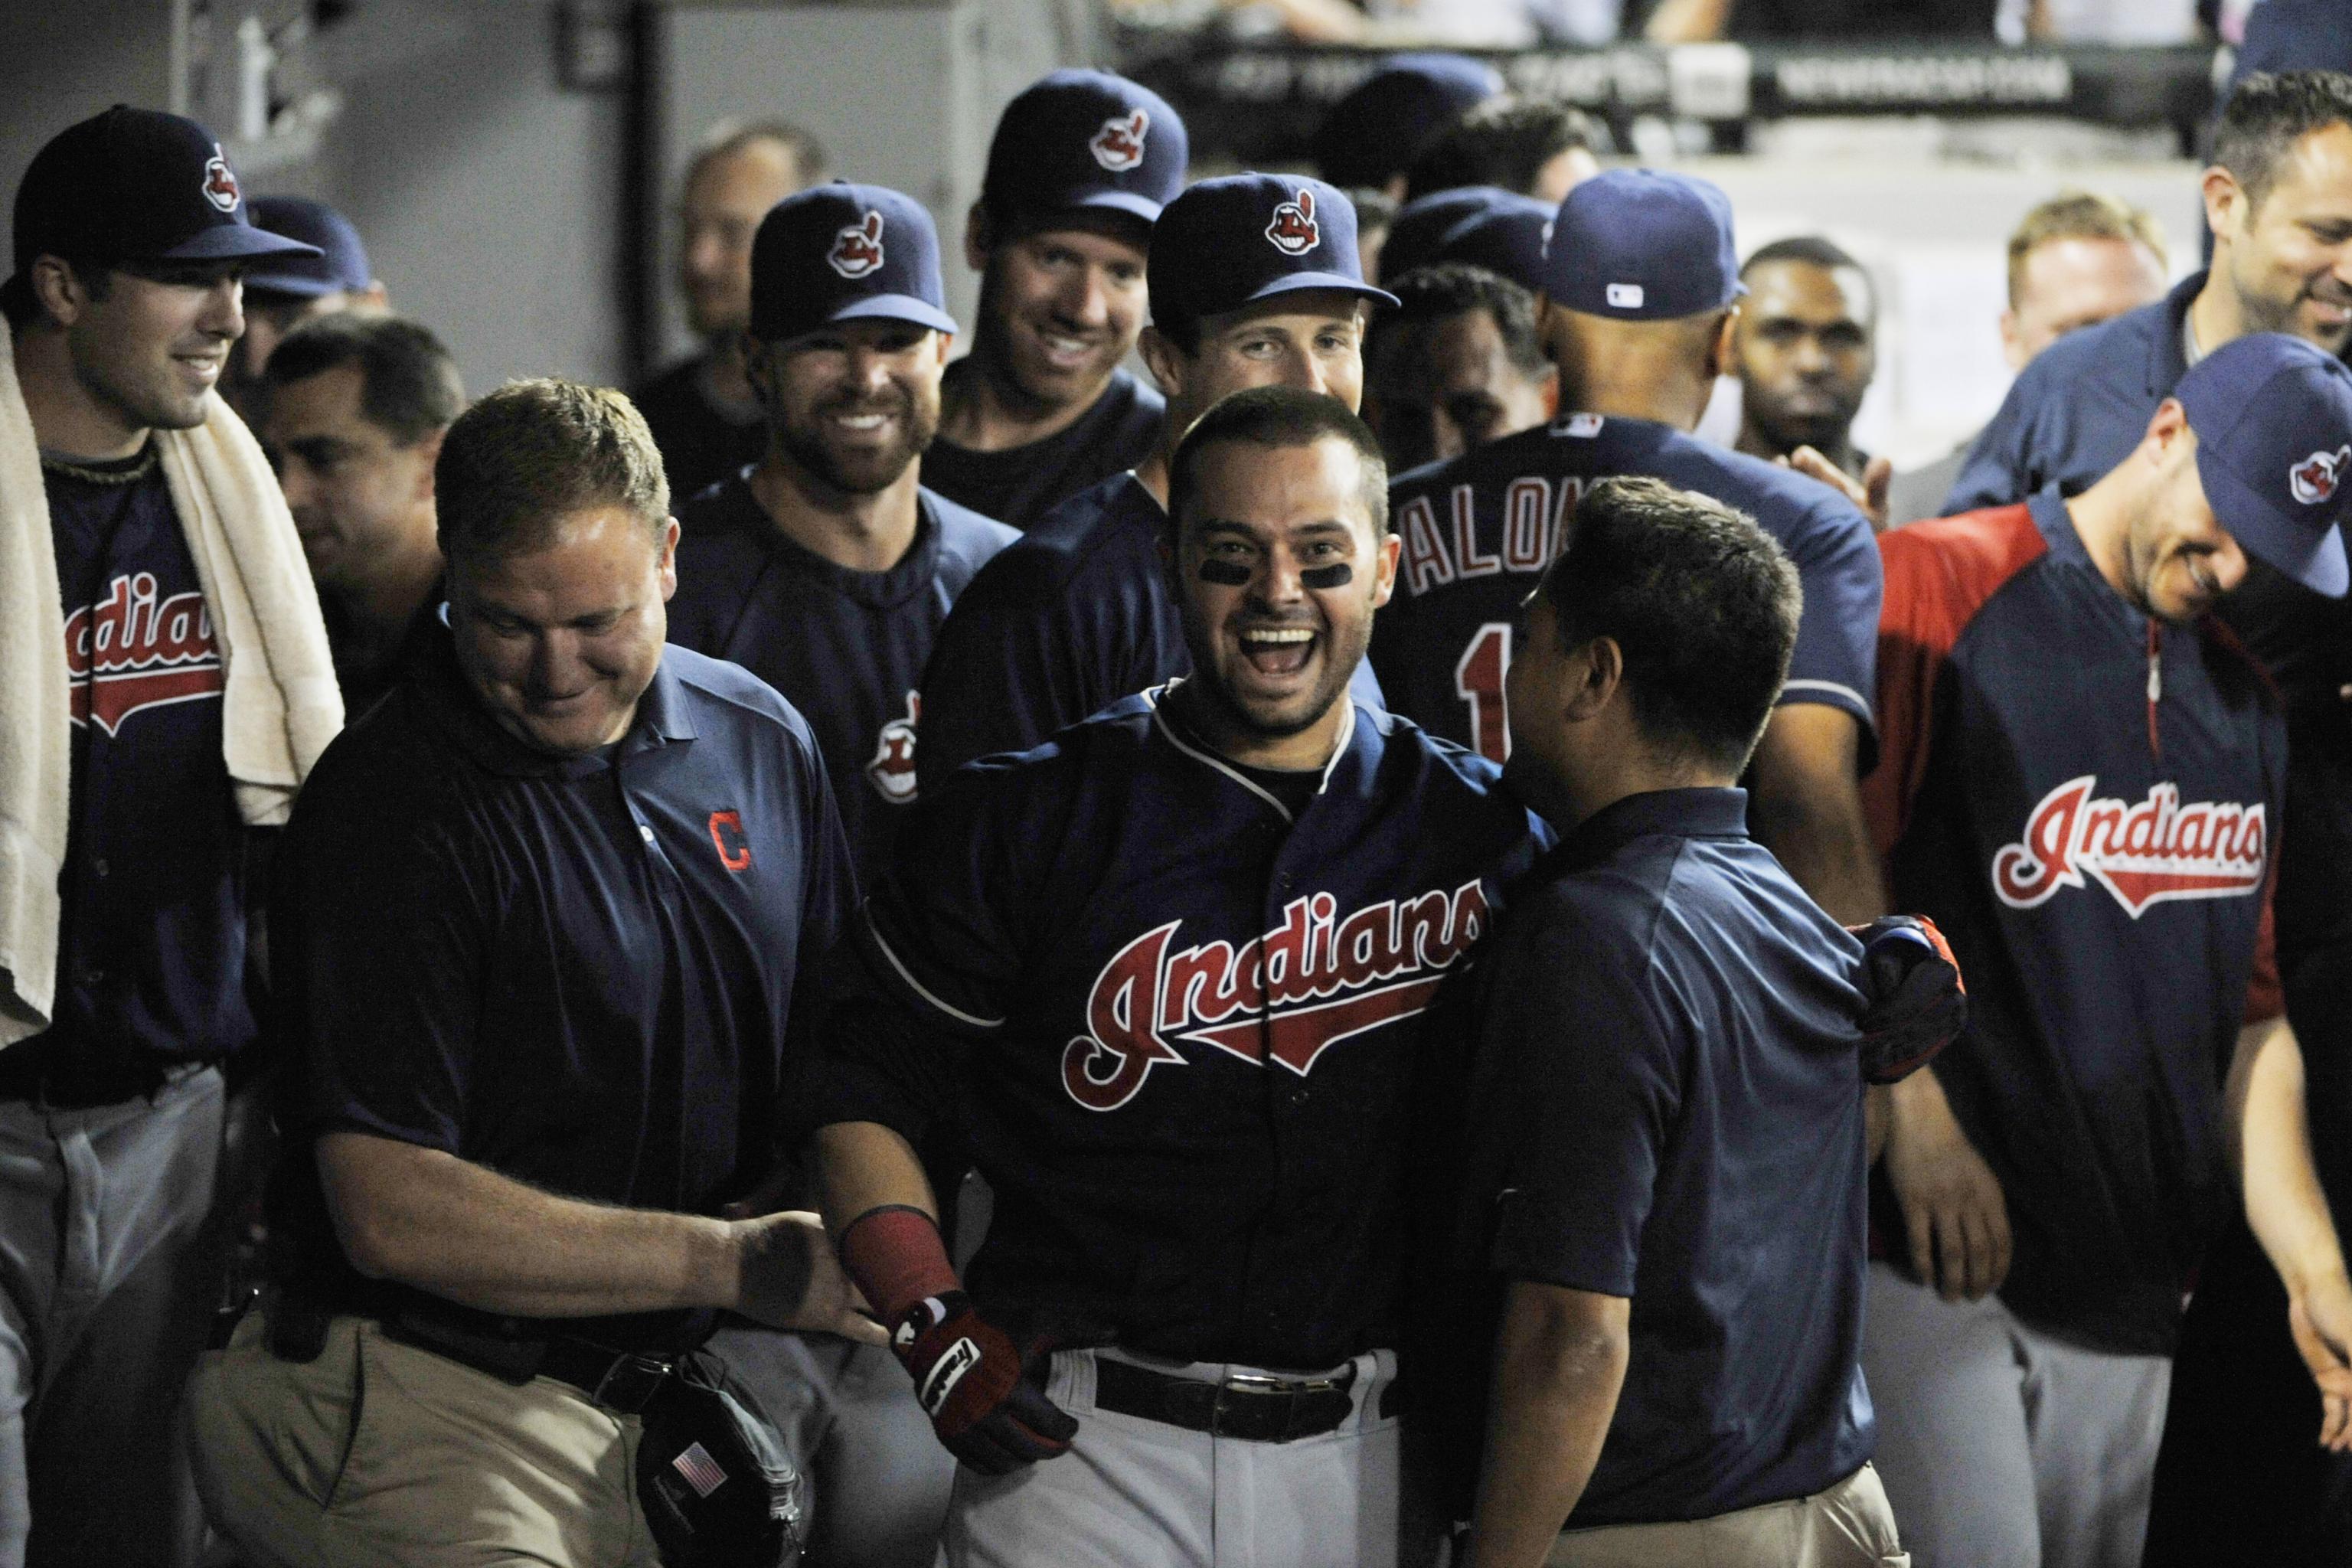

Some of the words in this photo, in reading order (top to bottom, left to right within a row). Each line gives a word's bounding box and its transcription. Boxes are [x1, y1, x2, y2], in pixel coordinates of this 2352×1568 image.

[709, 810, 751, 871] C
[1992, 774, 2266, 911] Indians
[1062, 878, 1493, 1112] Indians
